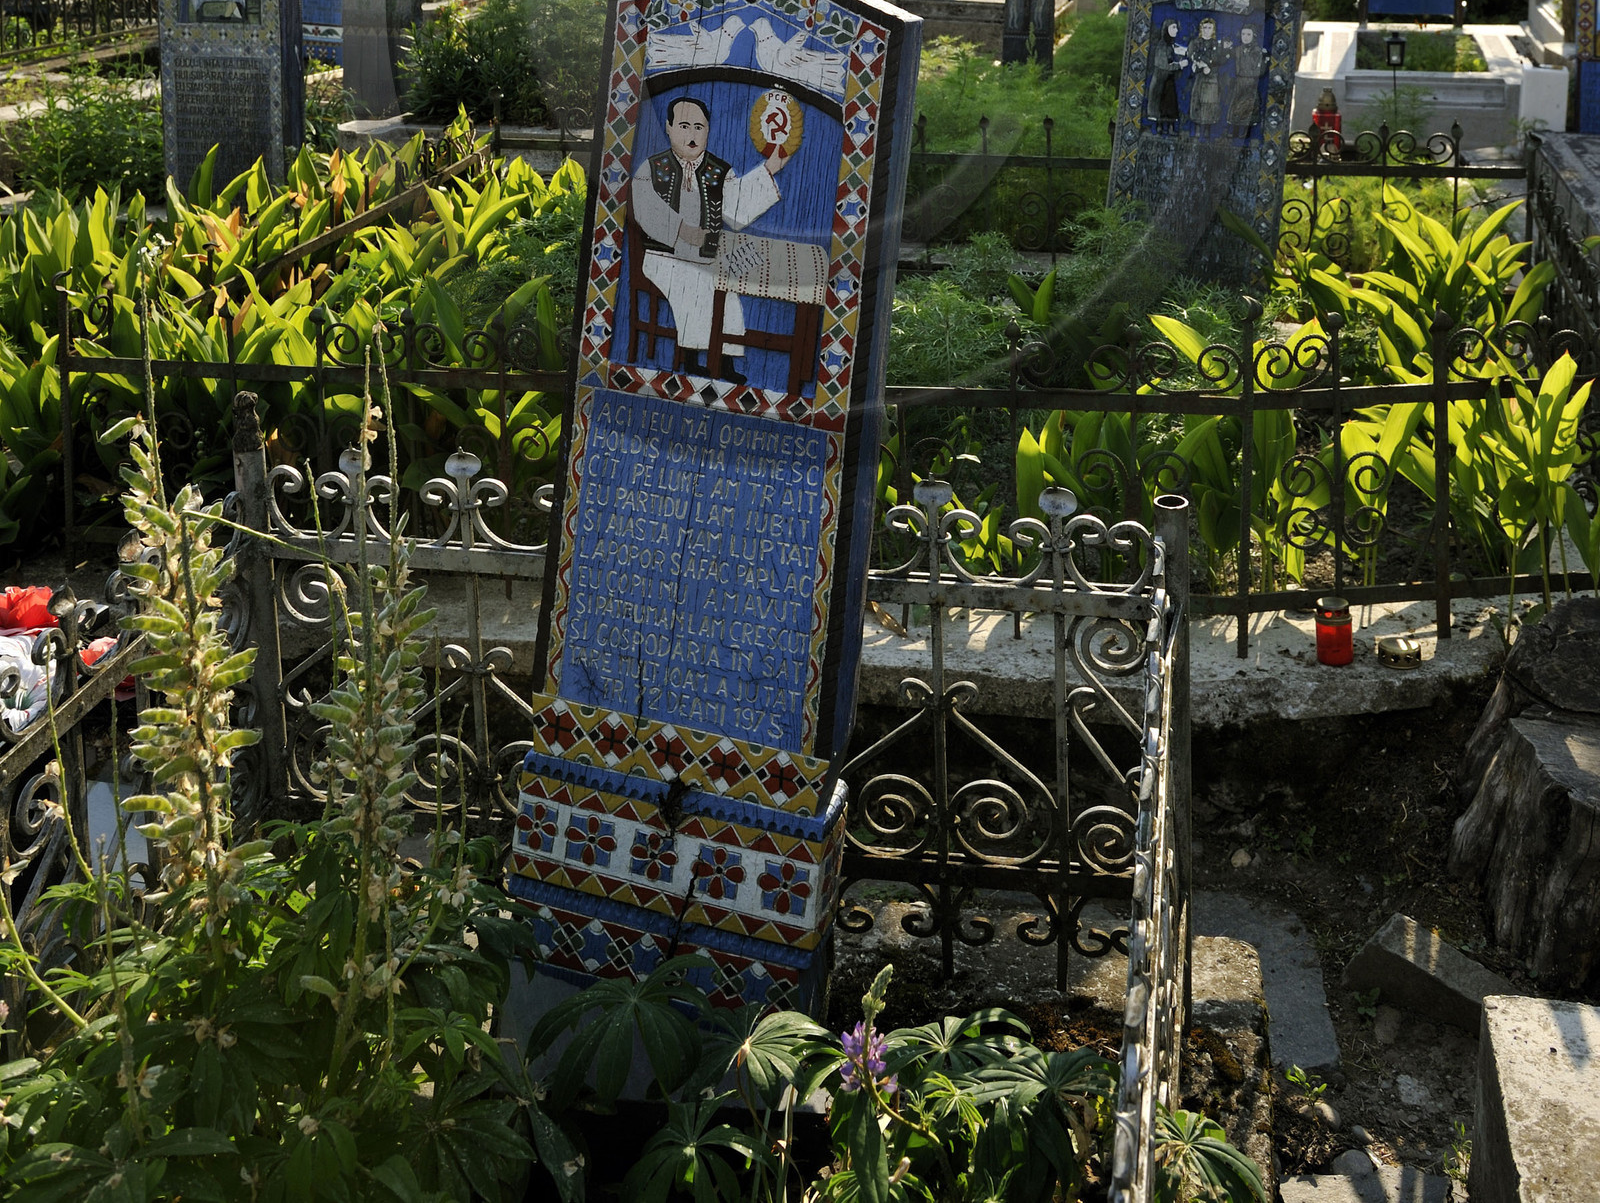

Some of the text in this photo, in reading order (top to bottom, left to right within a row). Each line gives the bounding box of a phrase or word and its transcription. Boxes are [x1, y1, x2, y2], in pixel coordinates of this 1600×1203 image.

[768, 93, 788, 104] PCR
[596, 401, 632, 427] ACI
[718, 423, 819, 459] ODIHNESC
[734, 452, 820, 487] NUMESC
[709, 476, 741, 501] AM
[728, 533, 814, 569] LUPTAT
[761, 653, 804, 685] SAT
[733, 705, 784, 740] 1975
